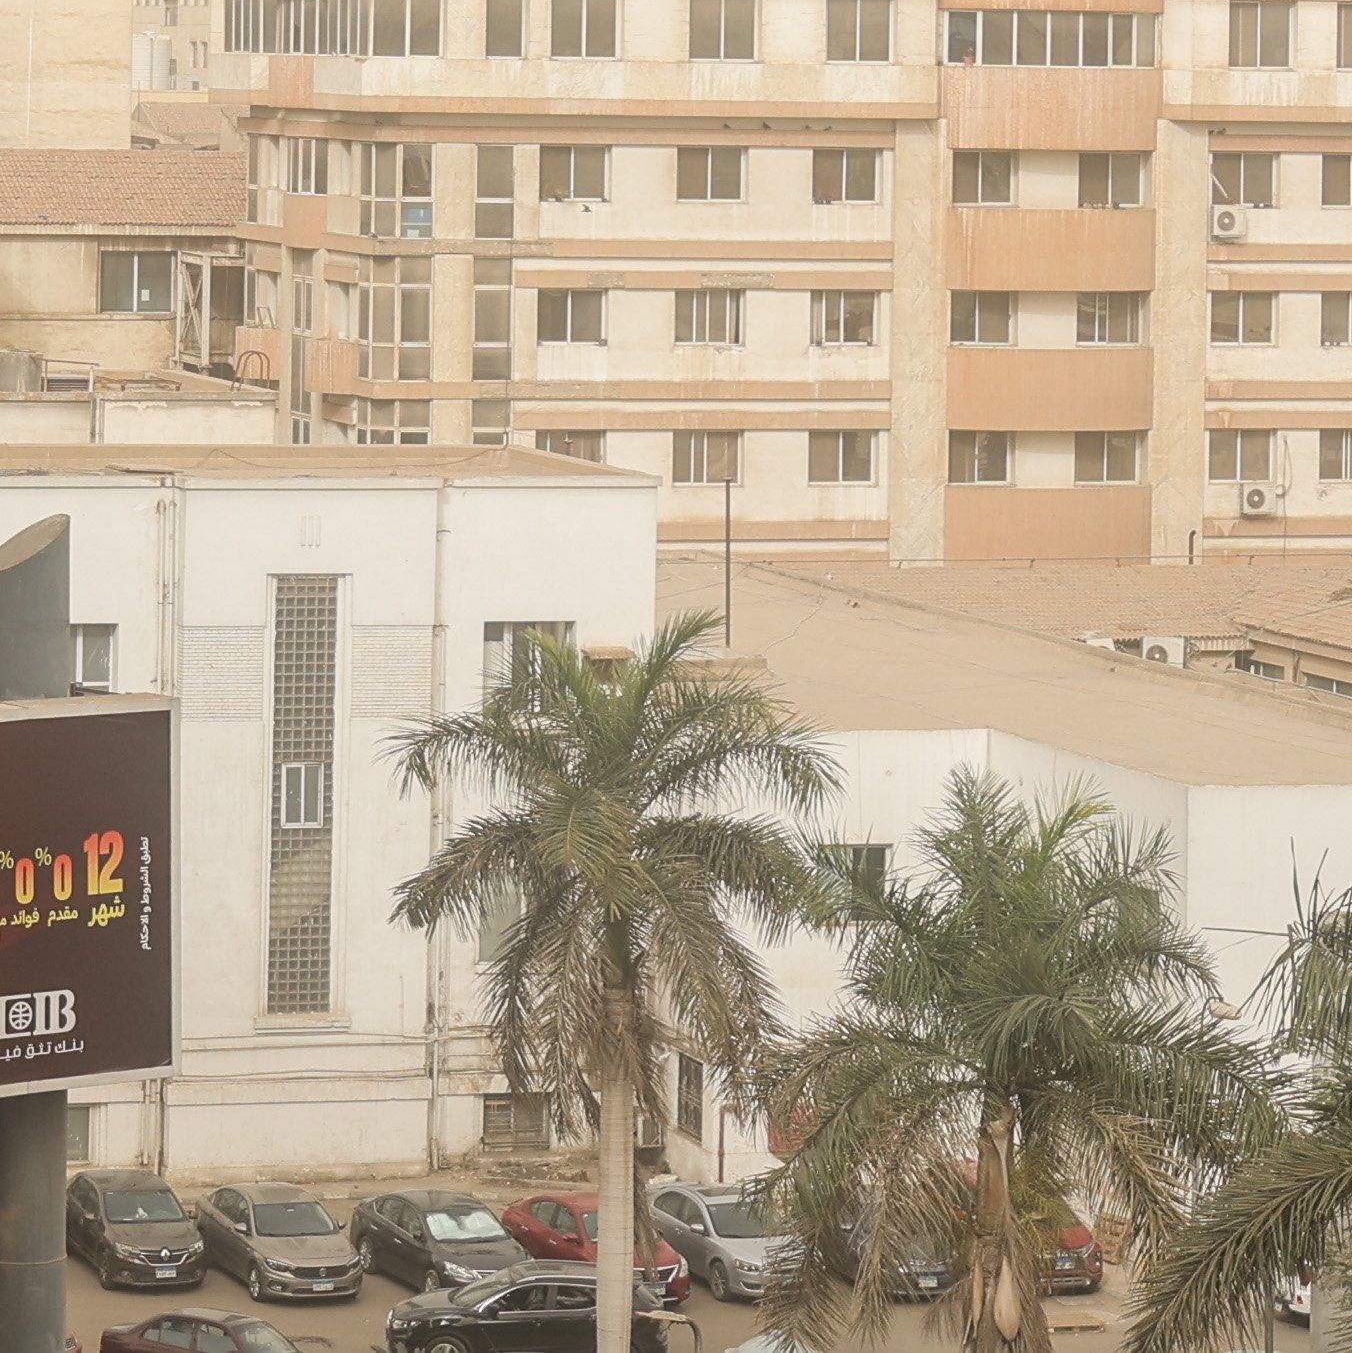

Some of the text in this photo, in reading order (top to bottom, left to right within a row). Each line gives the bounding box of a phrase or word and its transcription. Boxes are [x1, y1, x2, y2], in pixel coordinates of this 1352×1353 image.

[83, 830, 124, 896] 12
[10, 907, 40, 928] فوائد
[47, 906, 79, 927] مقدم
[87, 896, 126, 927] شهر
[24, 1041, 53, 1059] تثق
[54, 1038, 84, 1054] بنك
